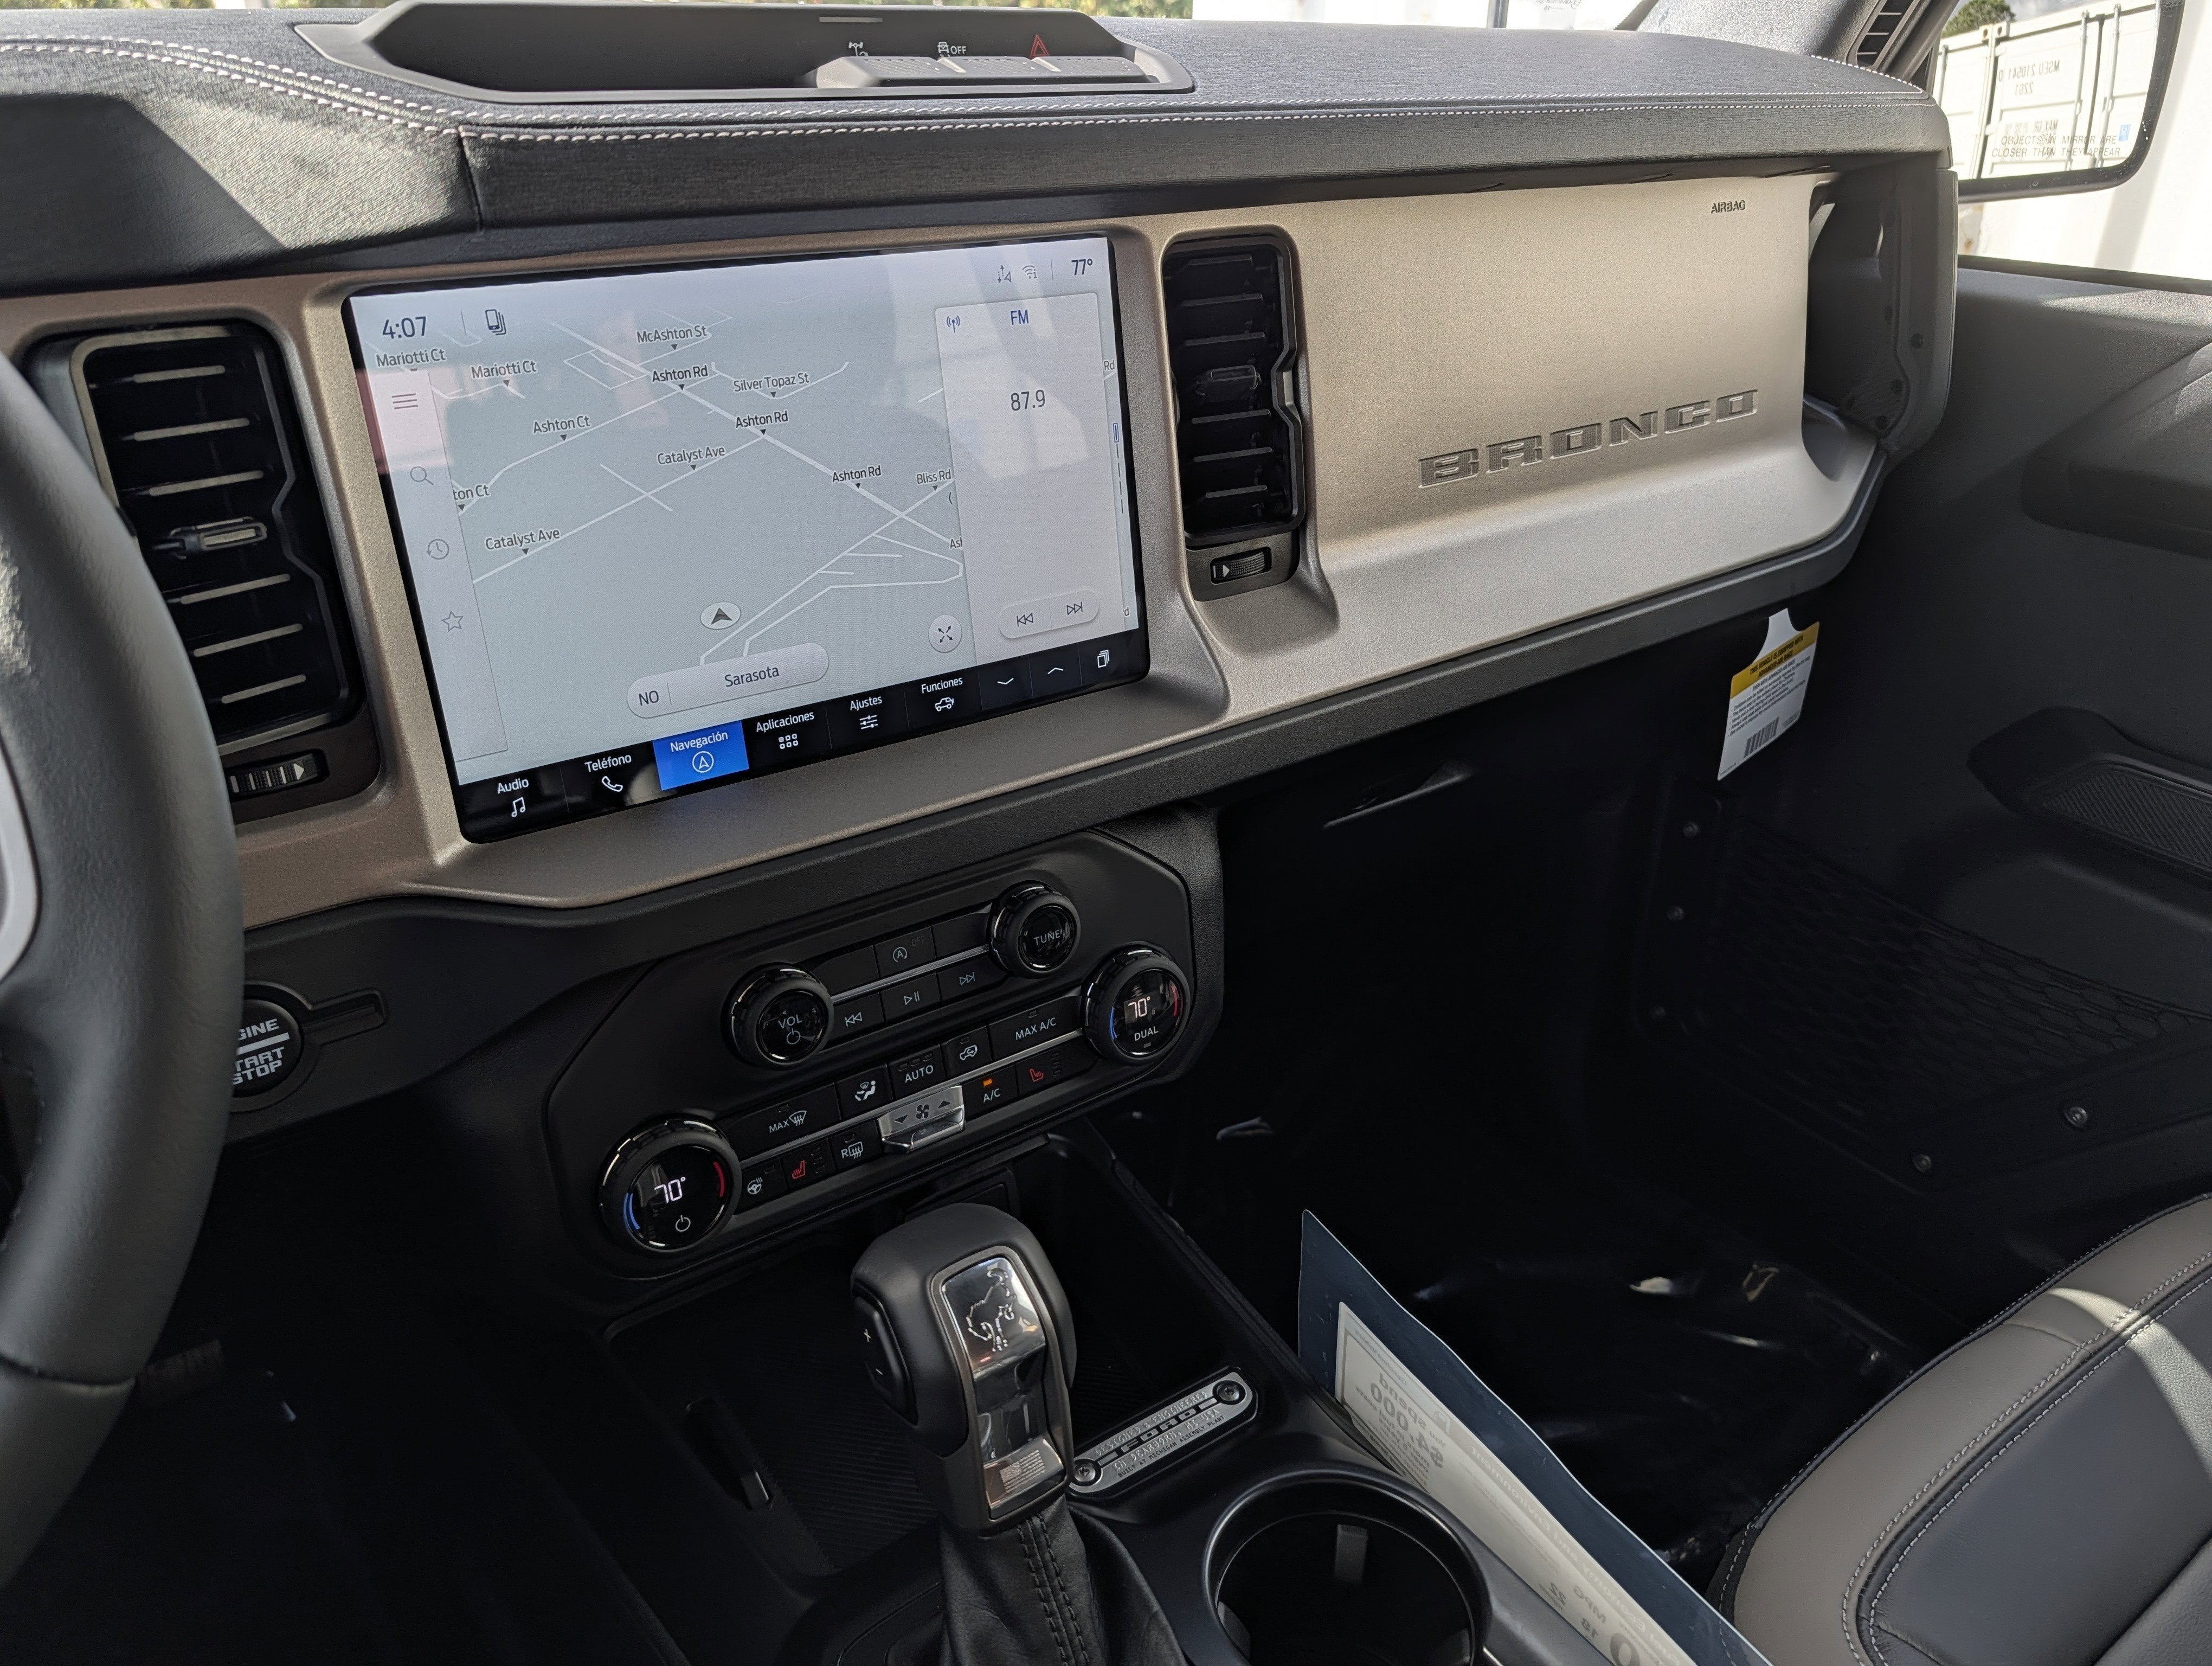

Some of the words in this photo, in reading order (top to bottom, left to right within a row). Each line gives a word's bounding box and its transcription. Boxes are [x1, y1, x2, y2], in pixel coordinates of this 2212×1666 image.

[950, 45, 967, 55] OFF
[2001, 136, 2042, 145] OBJECTS
[2062, 136, 2095, 144] MIRROR
[2100, 136, 2117, 144] ARE
[1992, 148, 2027, 157] CLOSER
[2033, 147, 2055, 156] THAN
[2061, 148, 2082, 156] THEY
[2087, 147, 2120, 156] APPEAR
[1711, 200, 1746, 214] AIRBAG
[1071, 258, 1094, 276] 77°
[1010, 310, 1030, 326] FM
[382, 316, 428, 339] 4:07
[637, 328, 693, 343] McAshton
[695, 326, 708, 338] St
[376, 350, 428, 368] Mariotti
[430, 348, 446, 363] Ct
[1104, 360, 1115, 370] Rd
[471, 362, 520, 380] Mariotti
[522, 361, 537, 374] Ct
[652, 367, 690, 383] Ashton
[691, 364, 709, 379] Rd
[733, 379, 762, 393] Silver
[764, 375, 797, 392] Topaz
[798, 373, 809, 386] St
[1009, 389, 1046, 412] 87.9
[533, 417, 574, 434] Ashton
[575, 415, 591, 429] Ct
[735, 414, 771, 428] Ashton
[773, 411, 789, 425] Rd
[1418, 389, 1758, 488] BRONCO
[657, 448, 702, 465] Catalyst
[703, 445, 725, 459] Ave
[832, 467, 867, 483] Ashton
[868, 465, 882, 479] Rd
[916, 471, 935, 485] Bliss
[936, 469, 952, 482] Rd
[475, 485, 490, 497] Ct
[485, 531, 535, 551] Catalyst
[536, 528, 561, 543] Ave
[638, 689, 659, 706] NO
[724, 665, 780, 688] Sarasota
[921, 676, 963, 694] Funciones
[850, 694, 883, 712] Ajustes
[755, 712, 815, 733] Aplicaciones
[670, 730, 729, 753] Navegación
[585, 753, 632, 772] Teléfono
[497, 777, 529, 793] Audio
[1033, 930, 1060, 946] TUNE
[777, 1014, 803, 1029] VOL
[1015, 1024, 1038, 1041] MAX
[1039, 1017, 1057, 1031] A/C
[1134, 1026, 1159, 1041] DUAL
[904, 1064, 934, 1084] AUTO
[982, 1088, 1001, 1103] A/C
[769, 1119, 789, 1133] MAX
[841, 1149, 849, 1159] R
[1093, 1426, 1141, 1457] DESIGNED
[1143, 1421, 1151, 1430] &
[1153, 1391, 1207, 1424] ENGINEERED
[1121, 1408, 1197, 1453] FORD
[1114, 1458, 1127, 1470] IN
[1132, 1431, 1182, 1462] DEARBORN,
[1184, 1419, 1199, 1431] MI
[1203, 1408, 1220, 1421] USA
[1117, 1464, 1137, 1478] BUILT
[1139, 1457, 1147, 1466] AT
[1149, 1441, 1178, 1461] MICHIGAN
[1179, 1425, 1206, 1444] ASSEMBLY
[1207, 1414, 1226, 1428] PLANT
